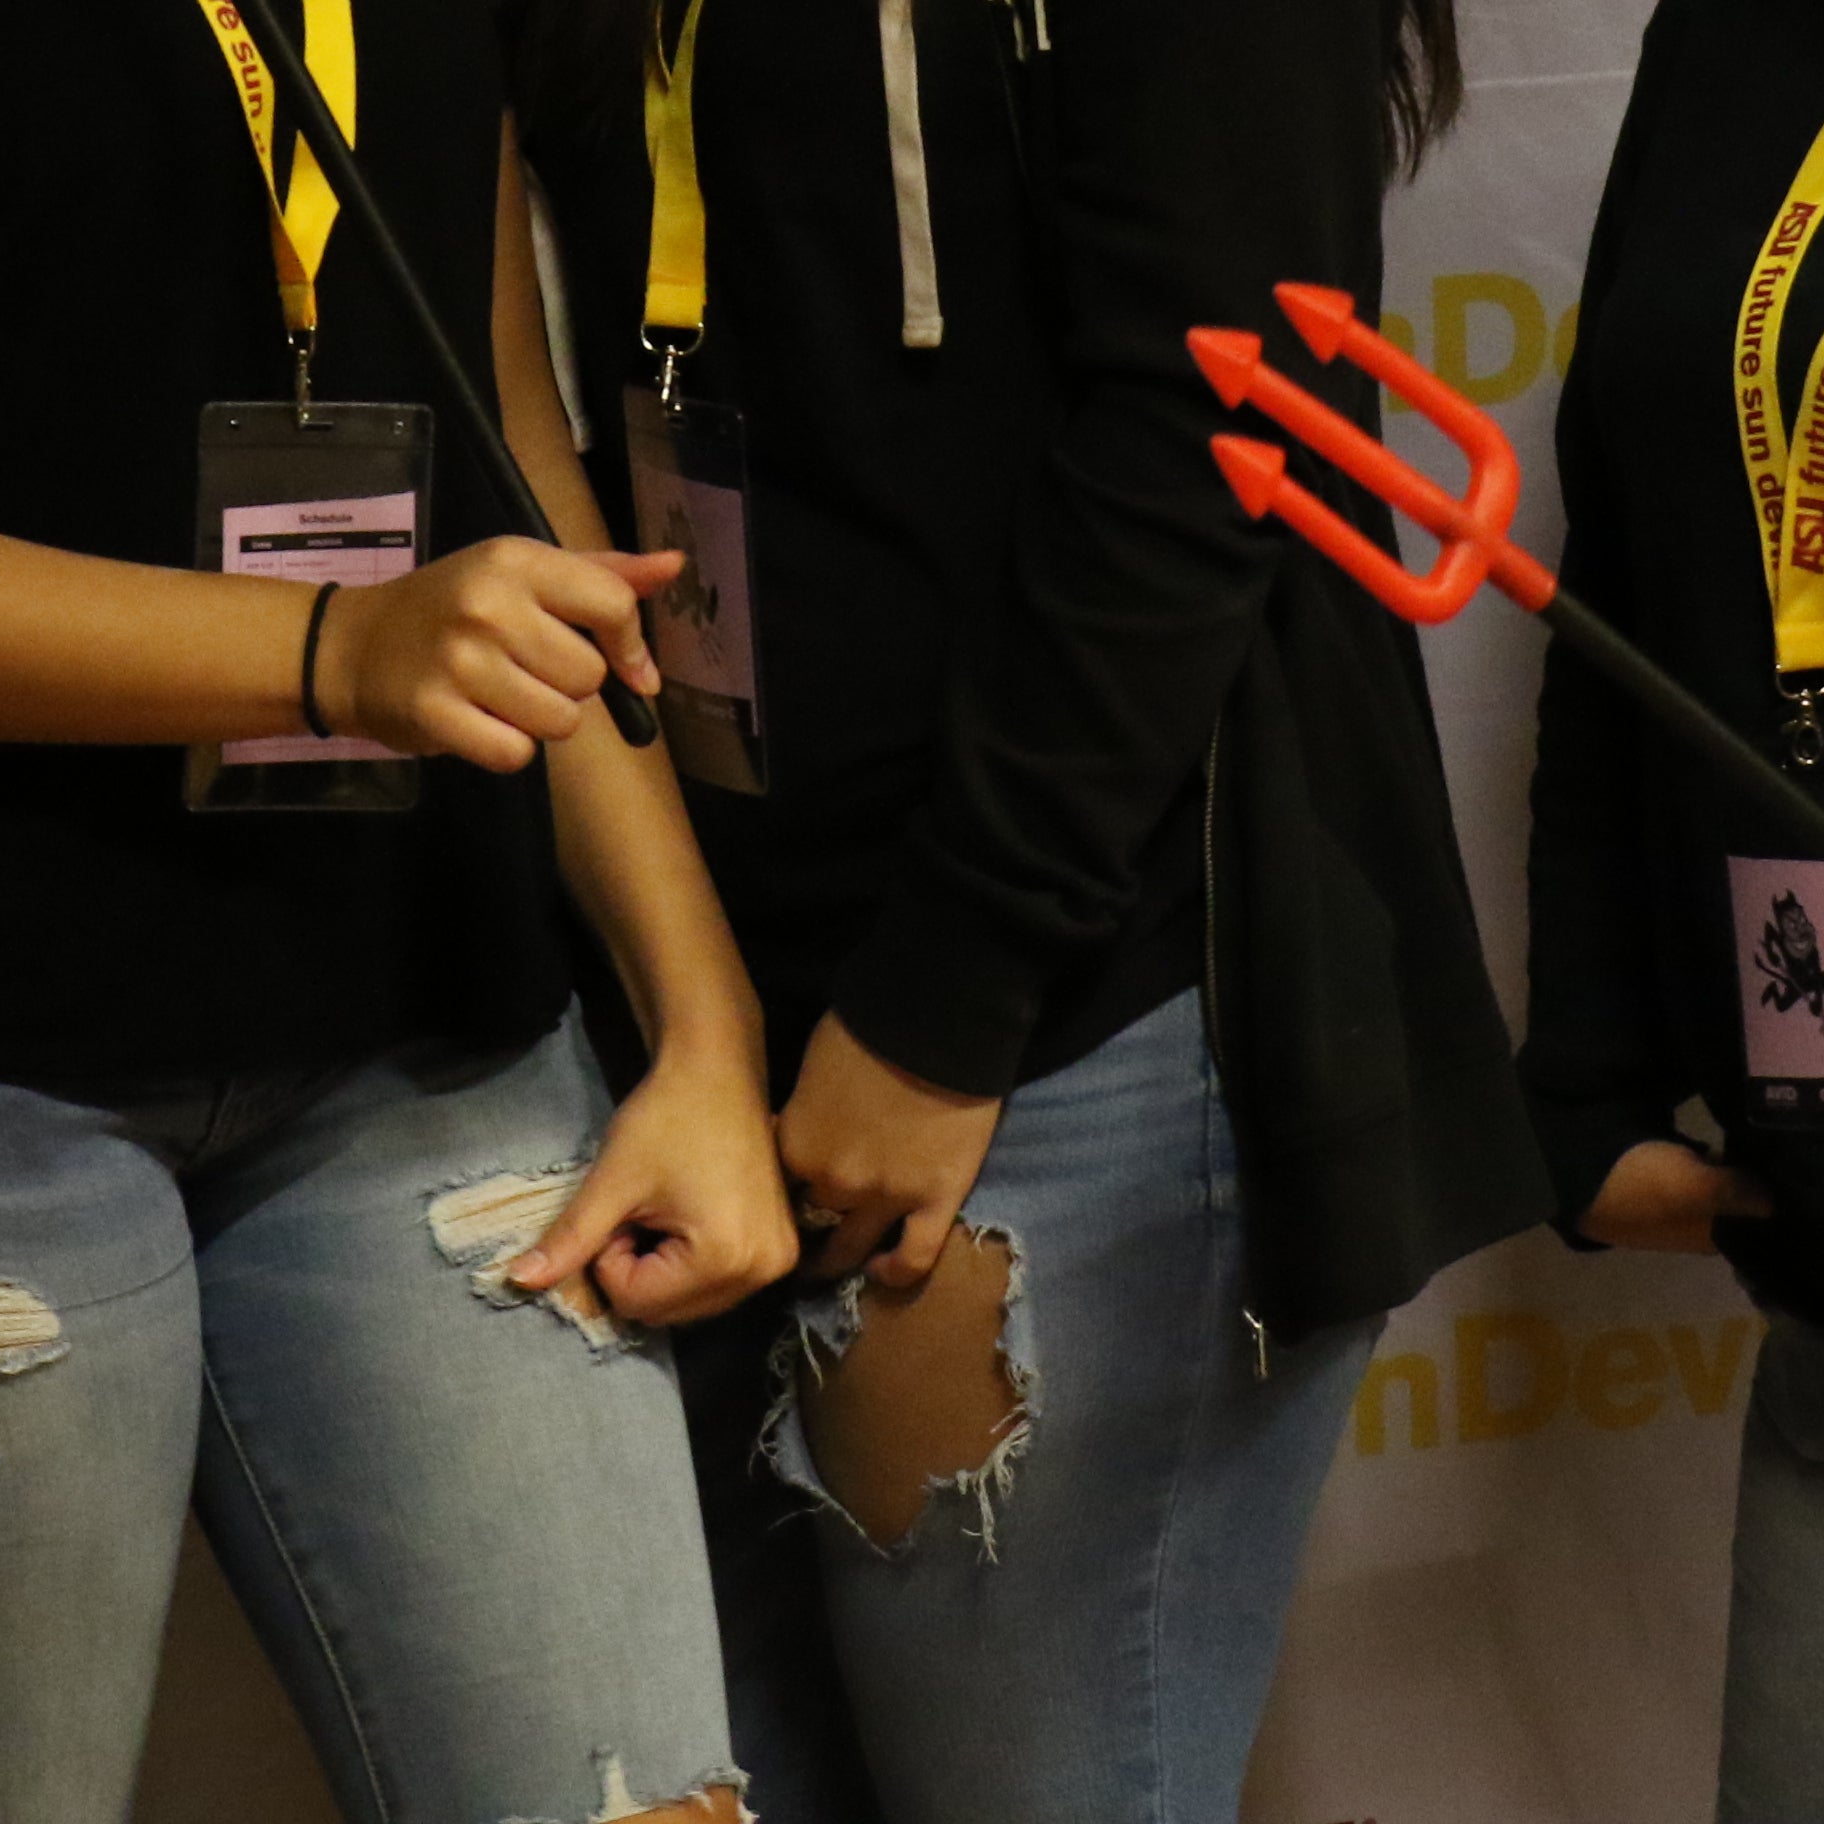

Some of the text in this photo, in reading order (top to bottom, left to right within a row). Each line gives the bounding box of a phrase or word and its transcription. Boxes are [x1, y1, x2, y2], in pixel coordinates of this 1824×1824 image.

[230, 41, 264, 118] sun
[1766, 202, 1820, 258] ASU
[1740, 266, 1788, 378] future
[1742, 386, 1773, 463] sun
